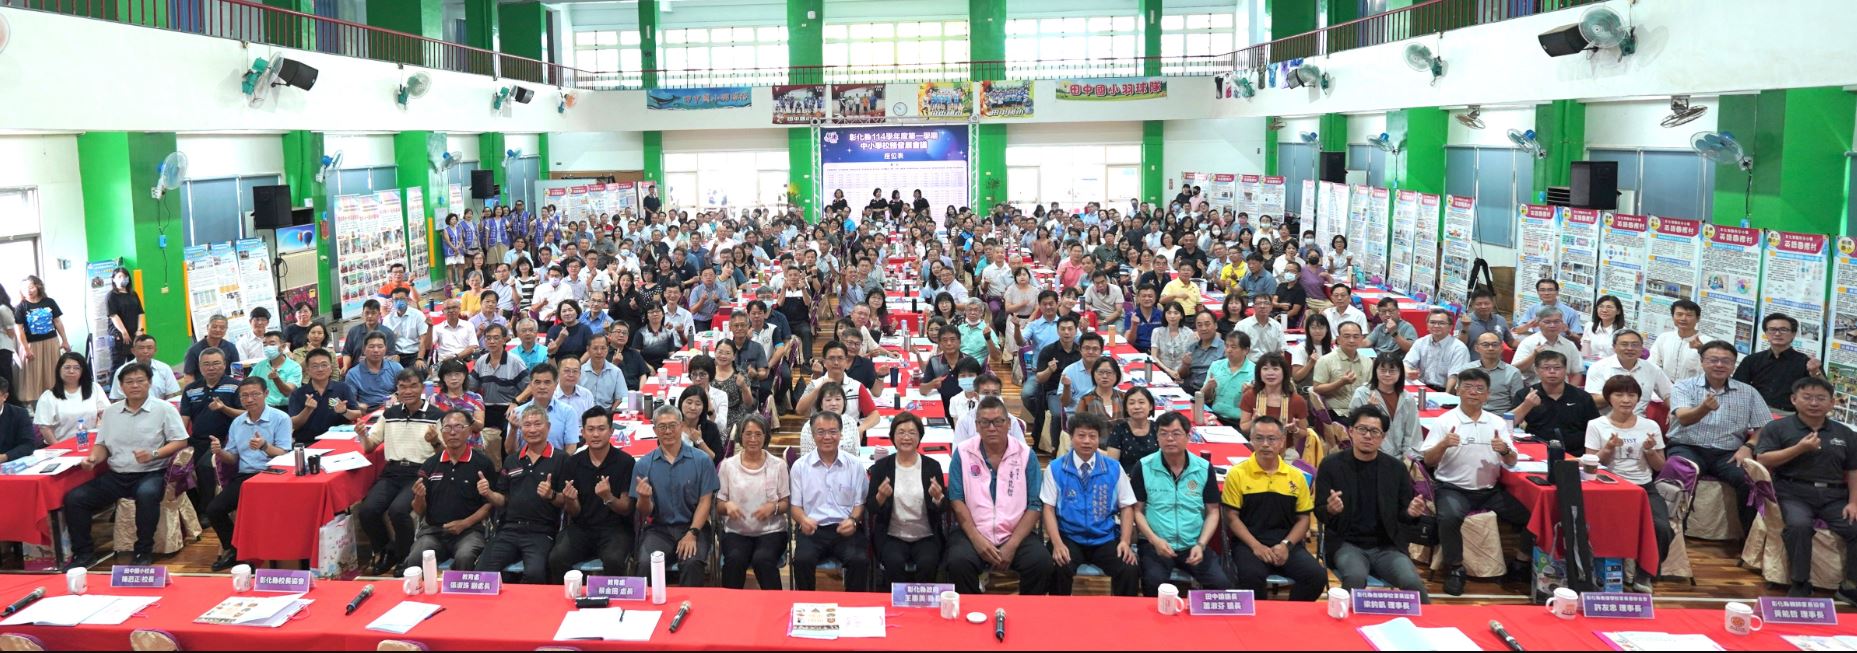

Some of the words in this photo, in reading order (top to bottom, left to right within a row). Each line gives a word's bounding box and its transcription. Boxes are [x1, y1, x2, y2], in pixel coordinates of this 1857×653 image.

[1069, 81, 1162, 96] 田中國小羽球隊
[907, 586, 939, 594] 彰化縣政府
[1618, 604, 1642, 613] 理事長
[1800, 610, 1825, 619] 理事長
